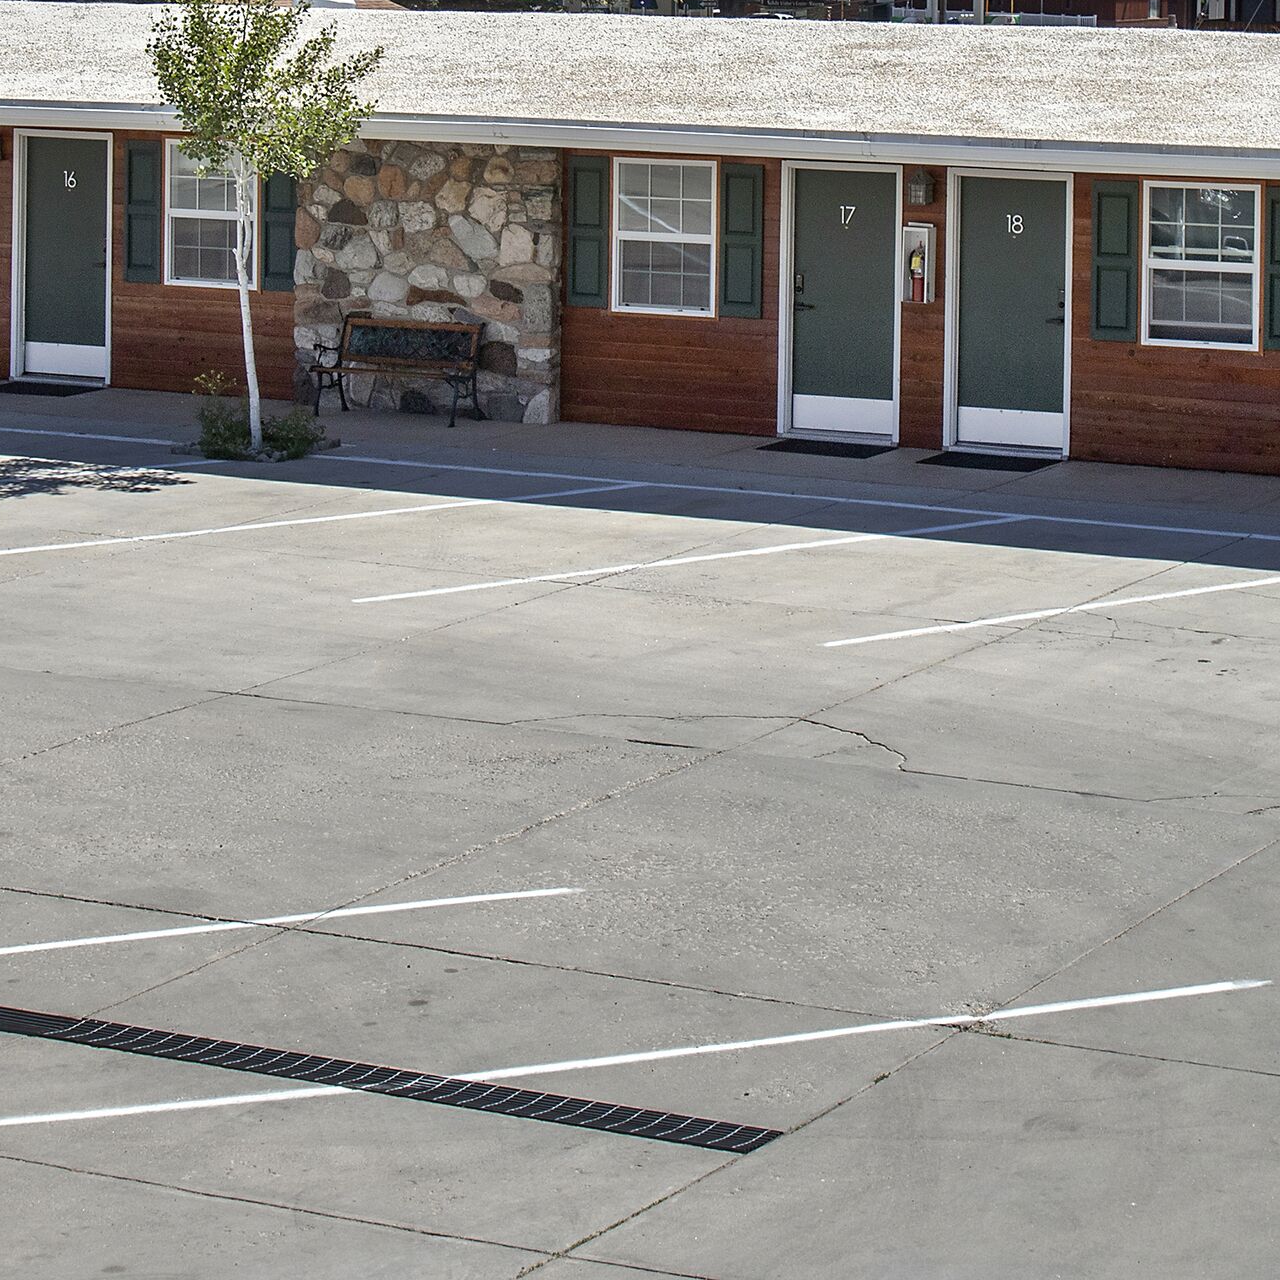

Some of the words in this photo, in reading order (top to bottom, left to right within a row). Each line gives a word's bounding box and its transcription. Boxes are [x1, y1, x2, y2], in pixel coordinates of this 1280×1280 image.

[63, 170, 77, 188] 16
[839, 205, 856, 224] 17
[1006, 214, 1024, 234] 18
